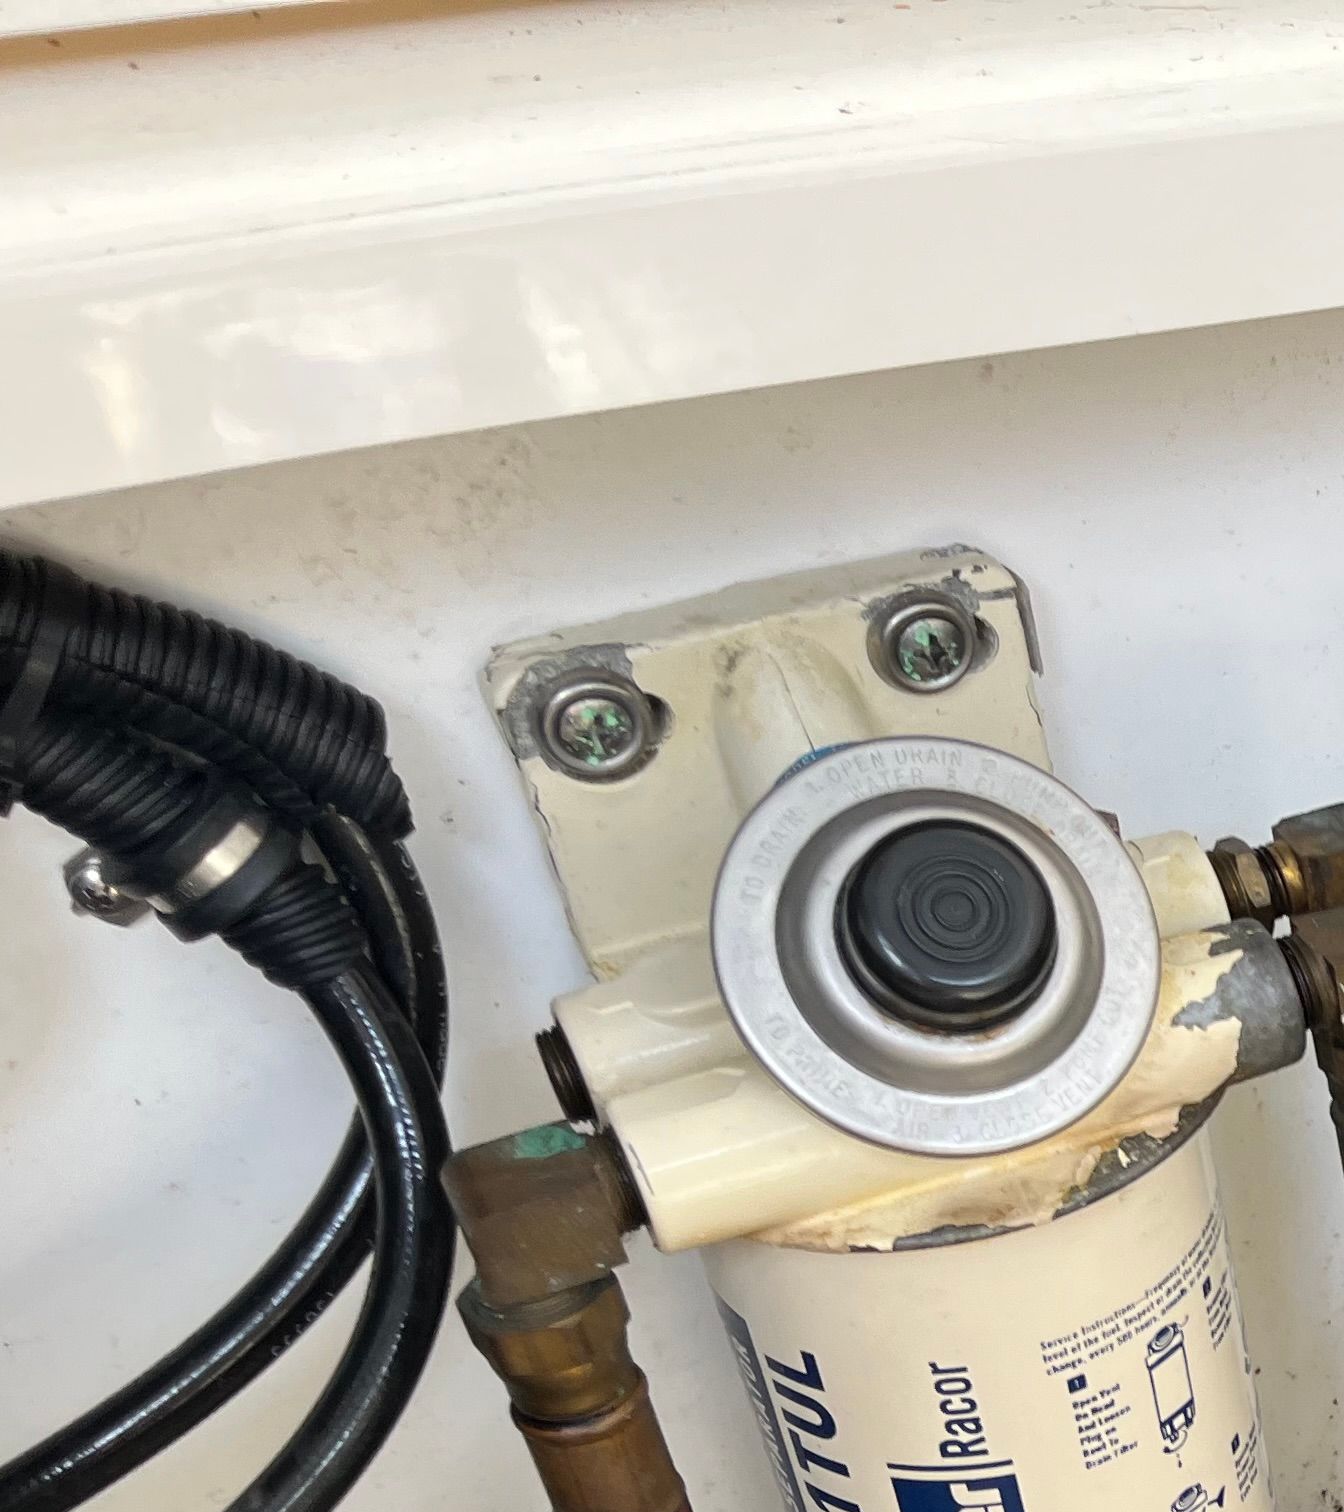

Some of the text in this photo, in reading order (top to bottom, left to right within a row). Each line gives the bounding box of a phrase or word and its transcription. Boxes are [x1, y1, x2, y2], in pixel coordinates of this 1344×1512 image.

[826, 749, 964, 786] OPEN DRAIN
[850, 767, 927, 802] WATER
[742, 876, 765, 907] TO
[1039, 1332, 1079, 1350] Service
[1043, 1348, 1068, 1363] level
[1071, 1343, 1081, 1354] of
[1084, 1335, 1099, 1349] the
[1089, 1342, 1115, 1360] every
[928, 1361, 990, 1459] Racor
[1072, 1394, 1097, 1409] Open
[1075, 1411, 1088, 1422] On
[1078, 1406, 1131, 1433] And Loosen
[1083, 1443, 1106, 1457] Bowl
[1085, 1440, 1138, 1469] Drain Filter
